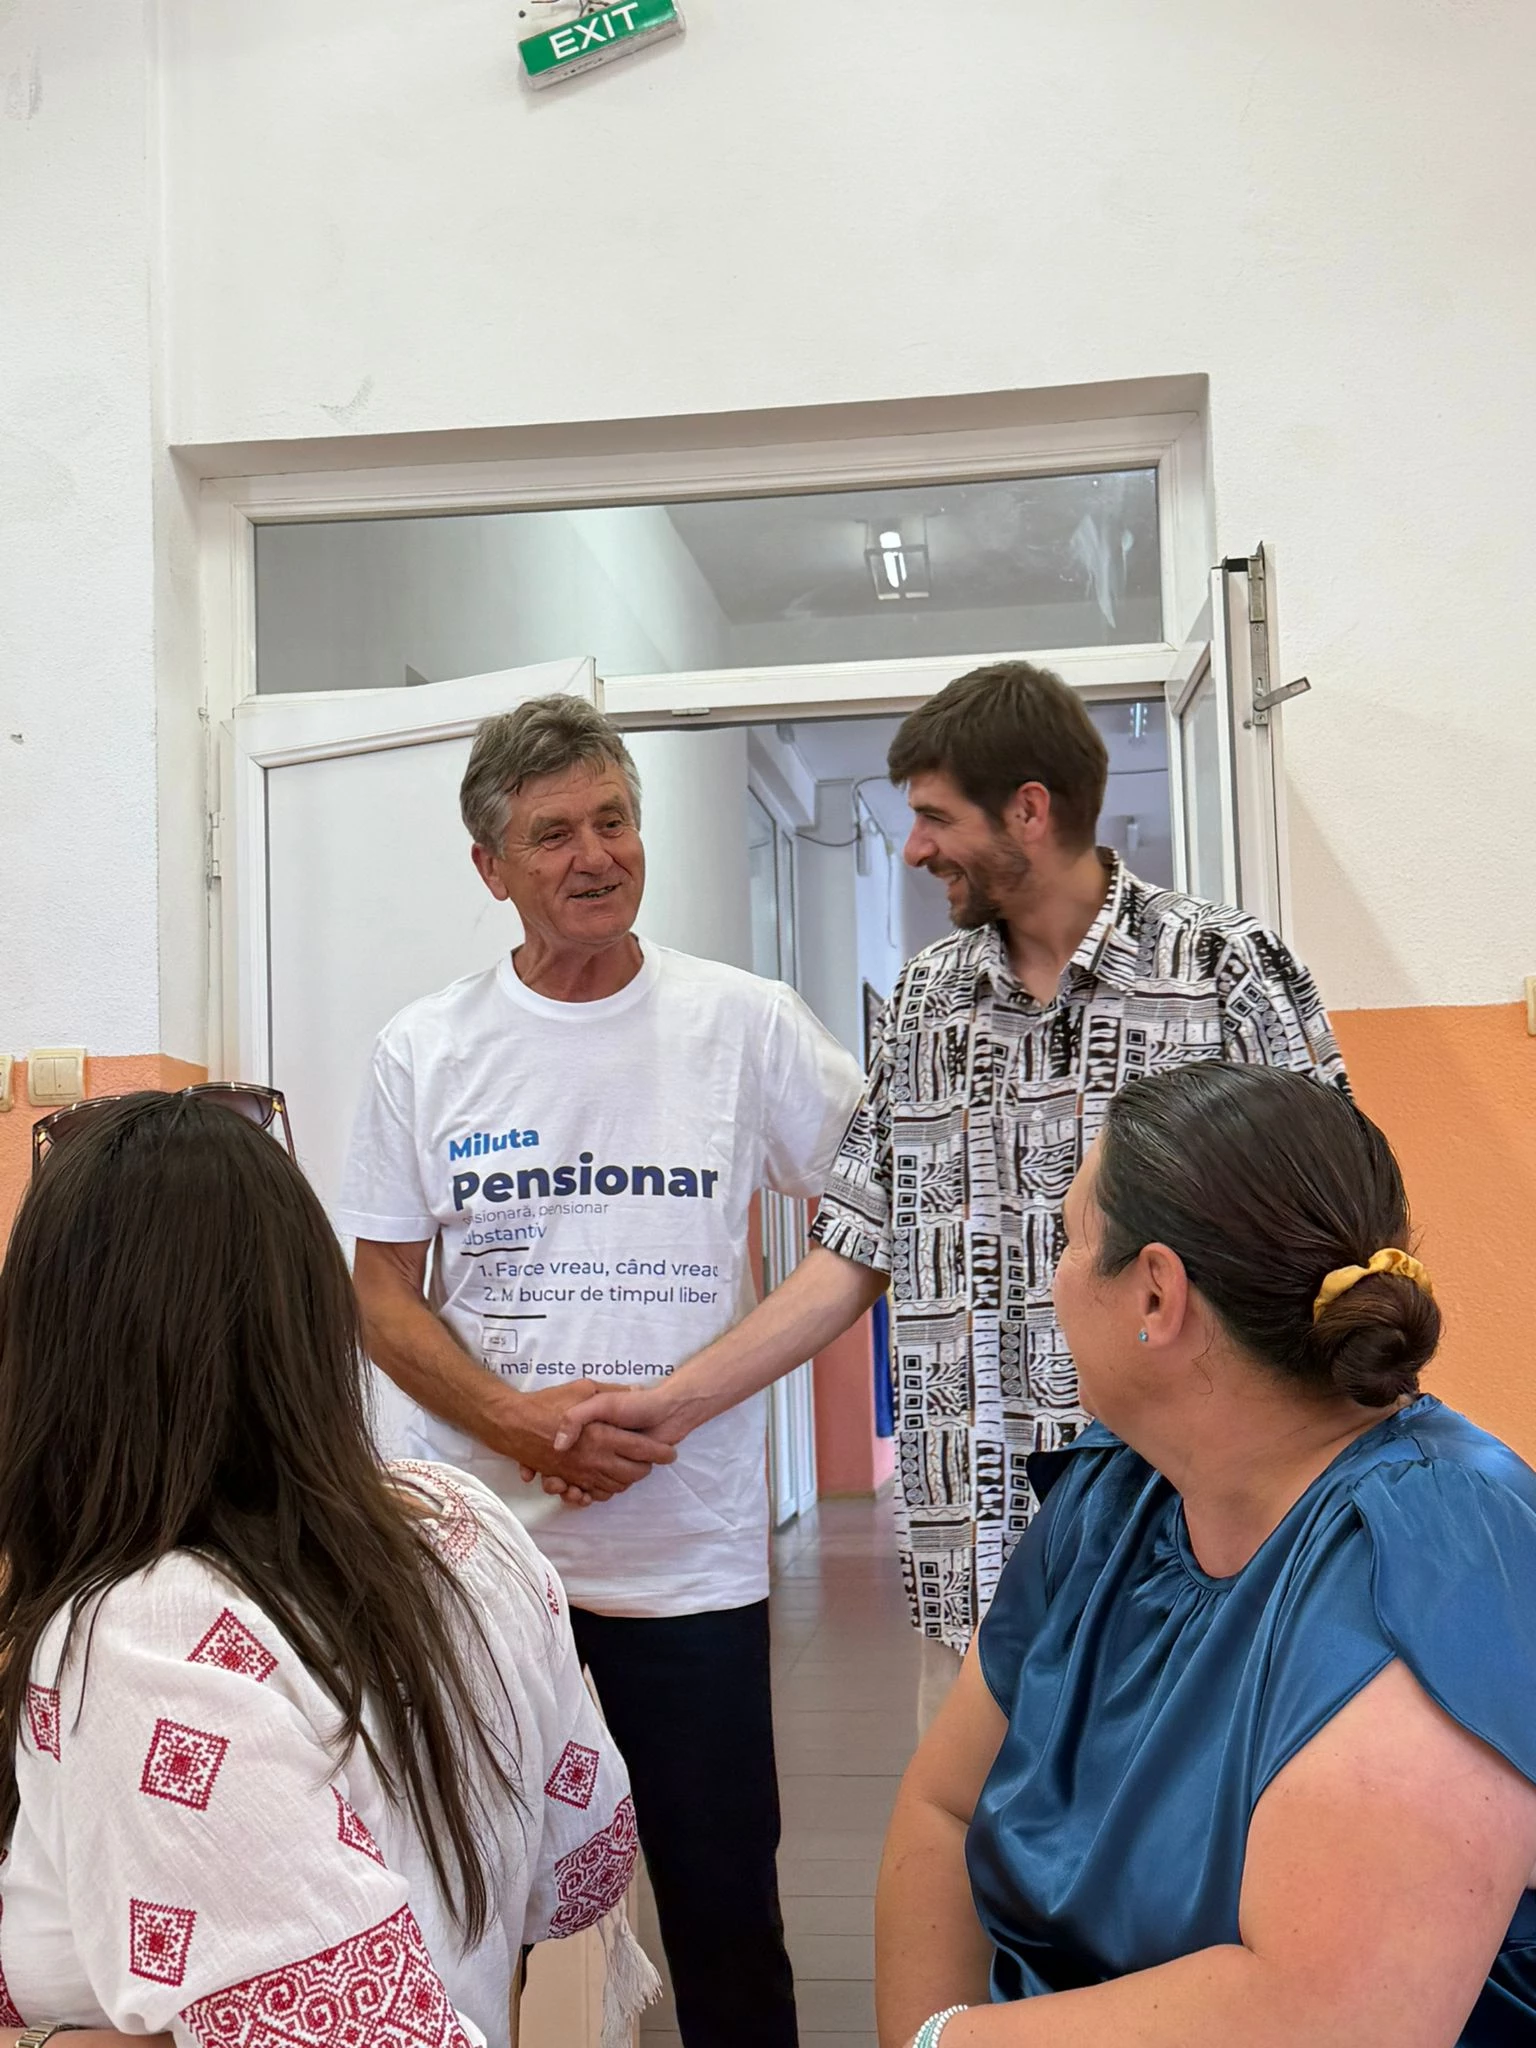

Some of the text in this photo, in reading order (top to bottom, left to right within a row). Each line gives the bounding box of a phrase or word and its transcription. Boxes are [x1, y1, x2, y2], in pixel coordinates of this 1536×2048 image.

[548, 2, 639, 60] EXIT
[449, 1128, 540, 1162] Miluta
[462, 1222, 548, 1246] ubstantiv
[478, 1264, 493, 1278] 1.
[550, 1261, 610, 1277] vreau,
[615, 1258, 667, 1276] când
[483, 1285, 497, 1302] 2.
[520, 1286, 576, 1302] bucur
[580, 1285, 604, 1302] de
[609, 1285, 674, 1305] timpul
[679, 1286, 718, 1304] liber
[535, 1360, 576, 1375] este
[582, 1359, 675, 1379] problema
